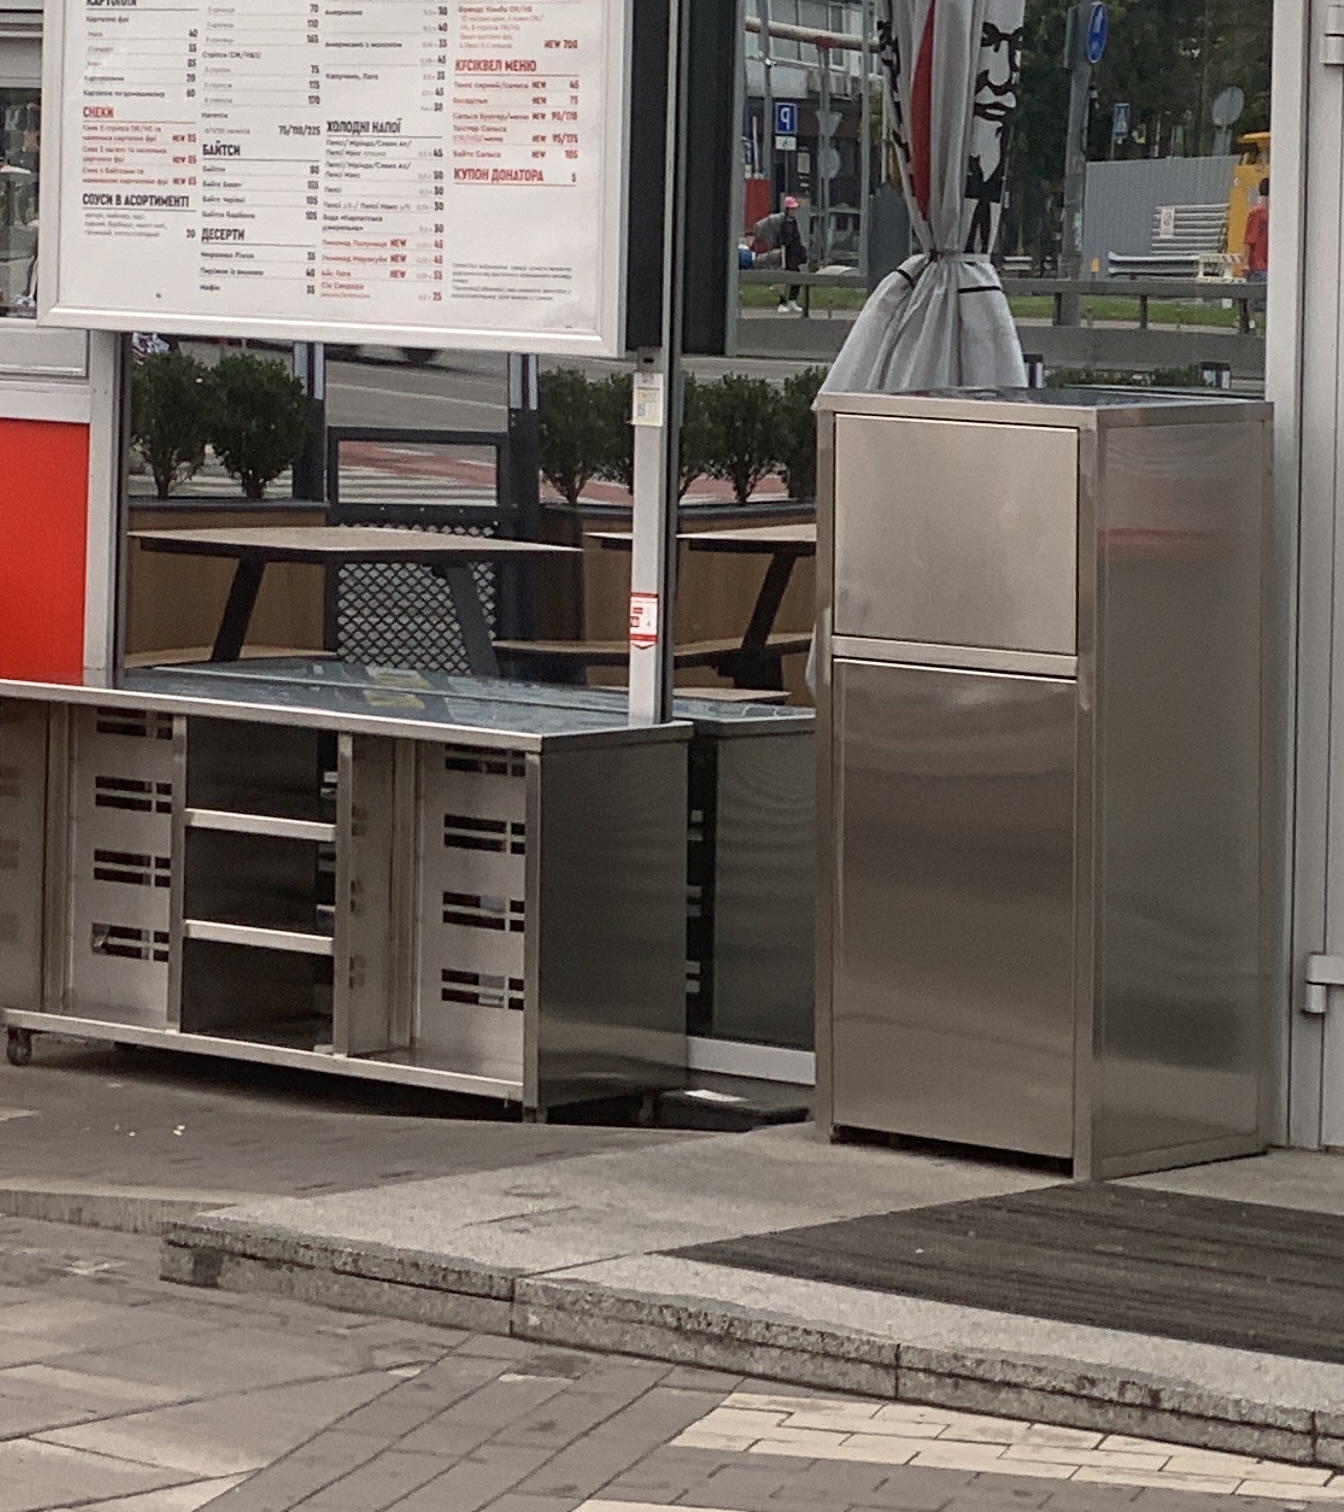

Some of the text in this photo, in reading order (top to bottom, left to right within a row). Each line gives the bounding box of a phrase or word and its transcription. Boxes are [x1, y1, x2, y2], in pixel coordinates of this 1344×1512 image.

[310, 3, 319, 13] 70
[544, 39, 561, 48] NEW
[505, 59, 537, 71] МЕНЮ
[83, 106, 114, 118] СНЕКИ
[326, 117, 403, 135] ХОЛОДНІ НАПОЇ
[202, 140, 241, 156] БАЙТСИ
[454, 168, 544, 183] КУПОН ДОНАТОРА
[82, 193, 190, 207] СОУСИ В АСОРТИМЕНТІ
[186, 229, 196, 238] 20
[201, 228, 245, 242] ДЕСЕРТИ
